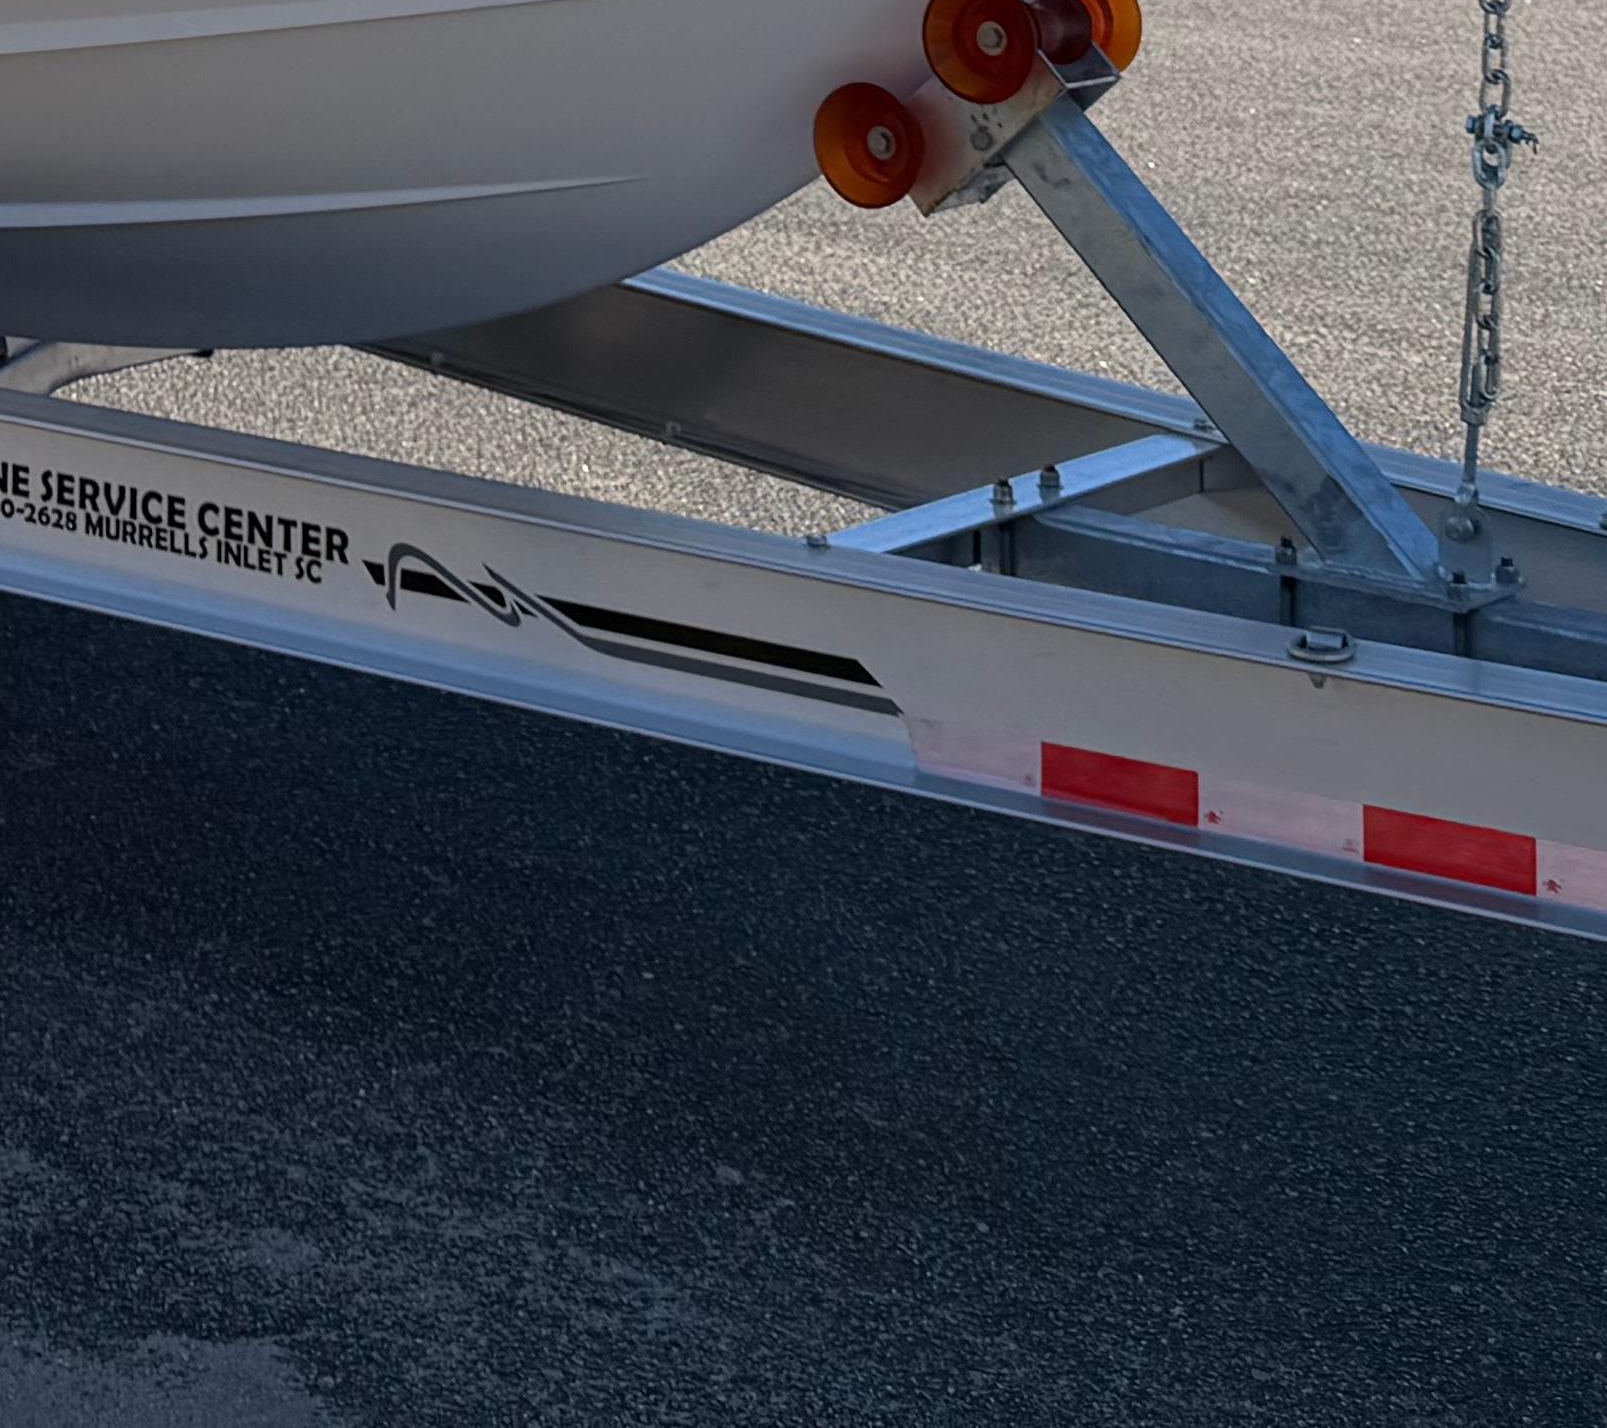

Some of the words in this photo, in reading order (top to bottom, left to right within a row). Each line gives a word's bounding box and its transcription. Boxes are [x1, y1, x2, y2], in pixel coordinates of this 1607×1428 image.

[40, 469, 186, 530] SERVICE
[197, 501, 349, 565] CENTER
[84, 512, 209, 560] MURRELLS
[216, 540, 286, 576] INLET
[294, 556, 322, 584] SC
